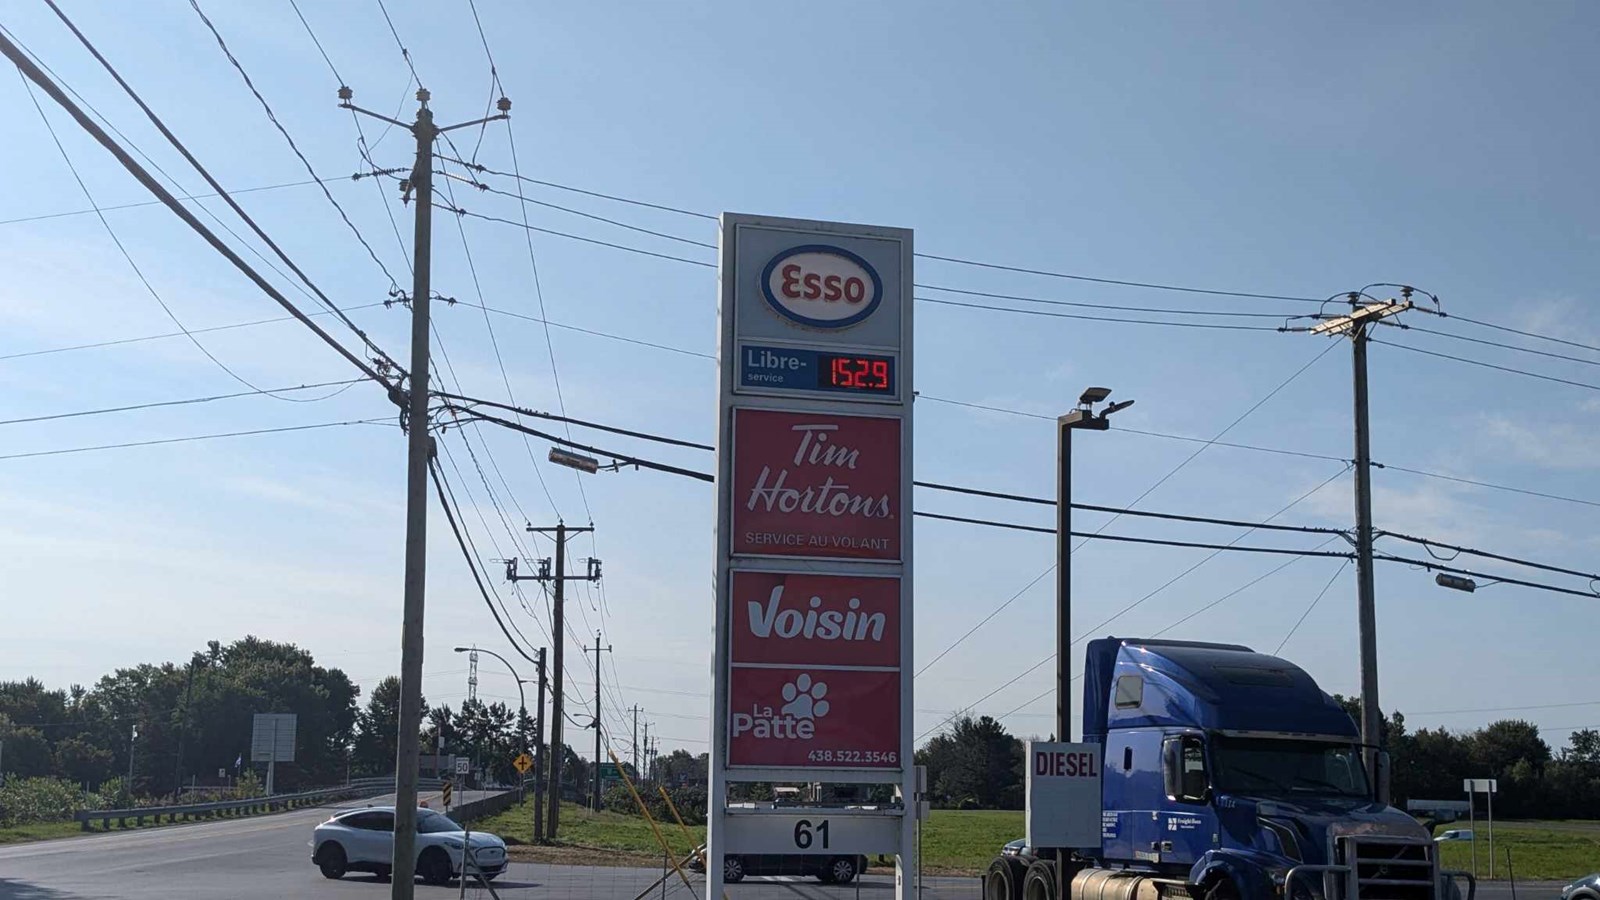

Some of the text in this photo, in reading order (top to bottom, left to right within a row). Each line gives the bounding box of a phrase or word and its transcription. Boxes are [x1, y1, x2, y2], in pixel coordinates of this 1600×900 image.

[781, 264, 865, 304] Esso
[748, 350, 807, 370] Libre-
[831, 358, 888, 388] 152.9
[747, 373, 784, 383] service
[791, 424, 860, 470] Tim
[747, 465, 890, 519] Hortons
[745, 532, 890, 550] SERVICE AU VOLANT
[747, 585, 886, 642] Voisin
[753, 703, 773, 718] La
[732, 712, 815, 739] Patte
[457, 762, 468, 773] 50
[808, 750, 897, 763] 438.522.3546
[1035, 751, 1098, 777] DIESEL
[793, 819, 830, 849] 61
